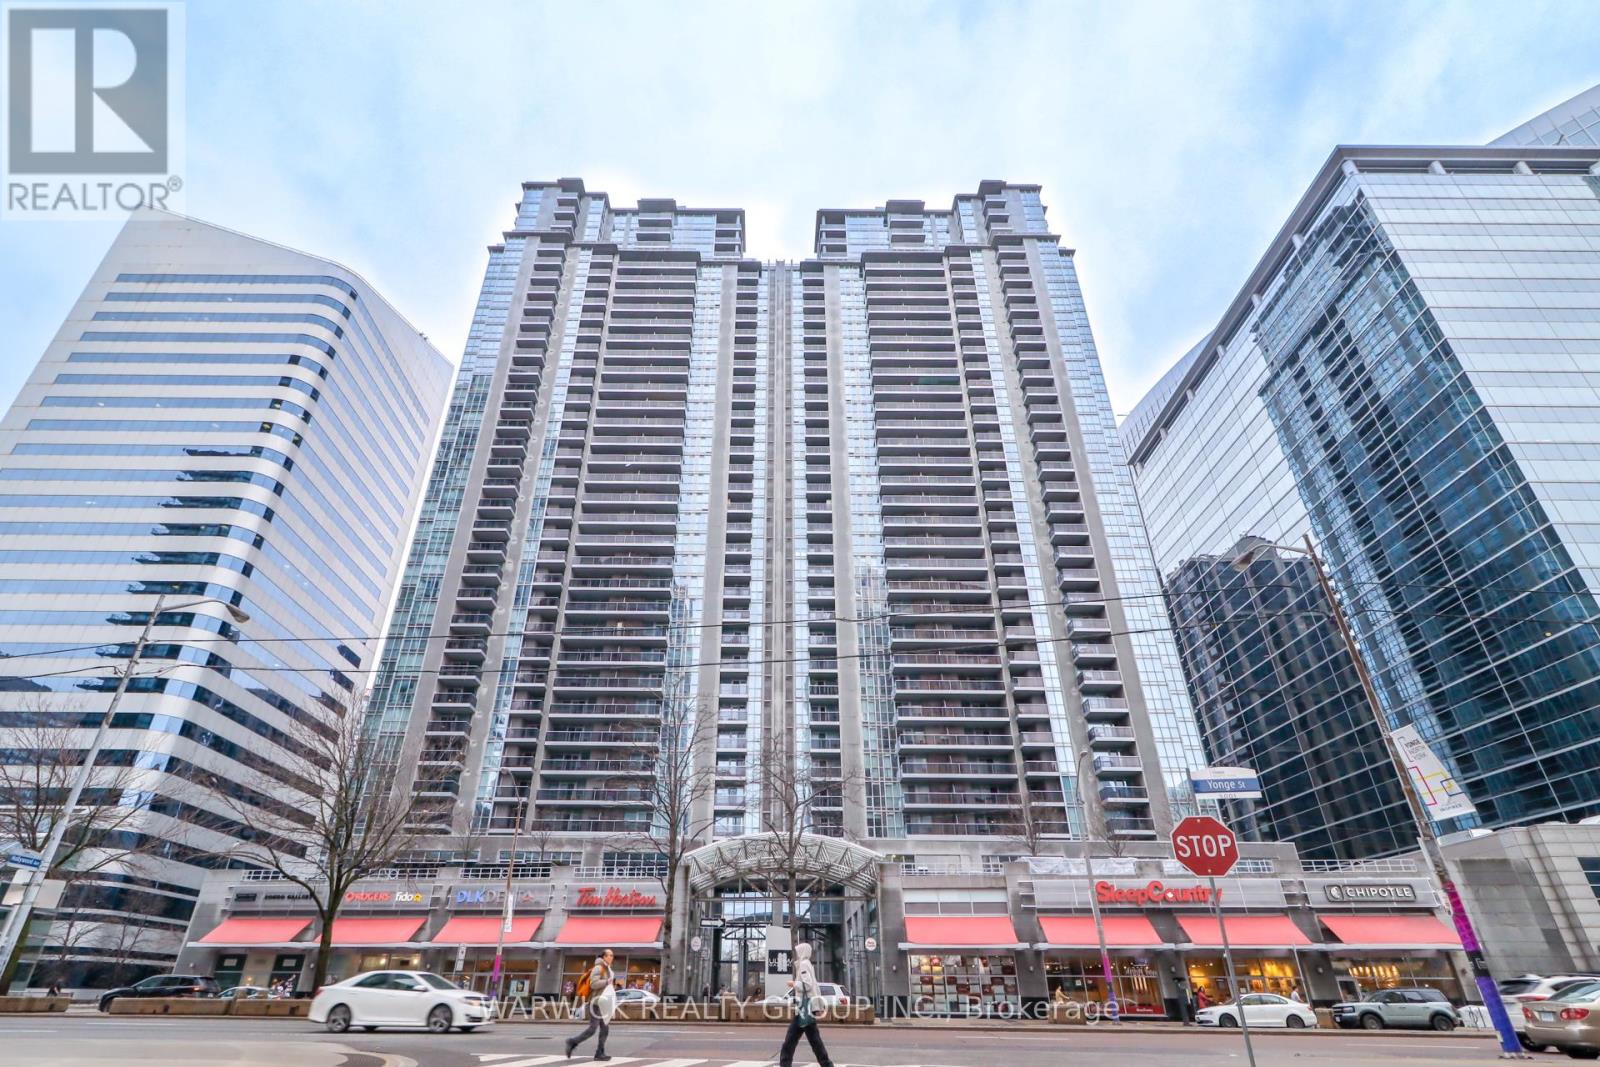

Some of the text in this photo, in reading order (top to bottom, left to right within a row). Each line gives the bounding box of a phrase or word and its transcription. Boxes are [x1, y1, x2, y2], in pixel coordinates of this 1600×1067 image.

[1207, 780, 1235, 791] Yonge
[1176, 834, 1232, 858] STOP
[395, 891, 413, 902] fido
[576, 886, 657, 906] Tim Hortons
[1346, 887, 1412, 897] CHIPOTLE
